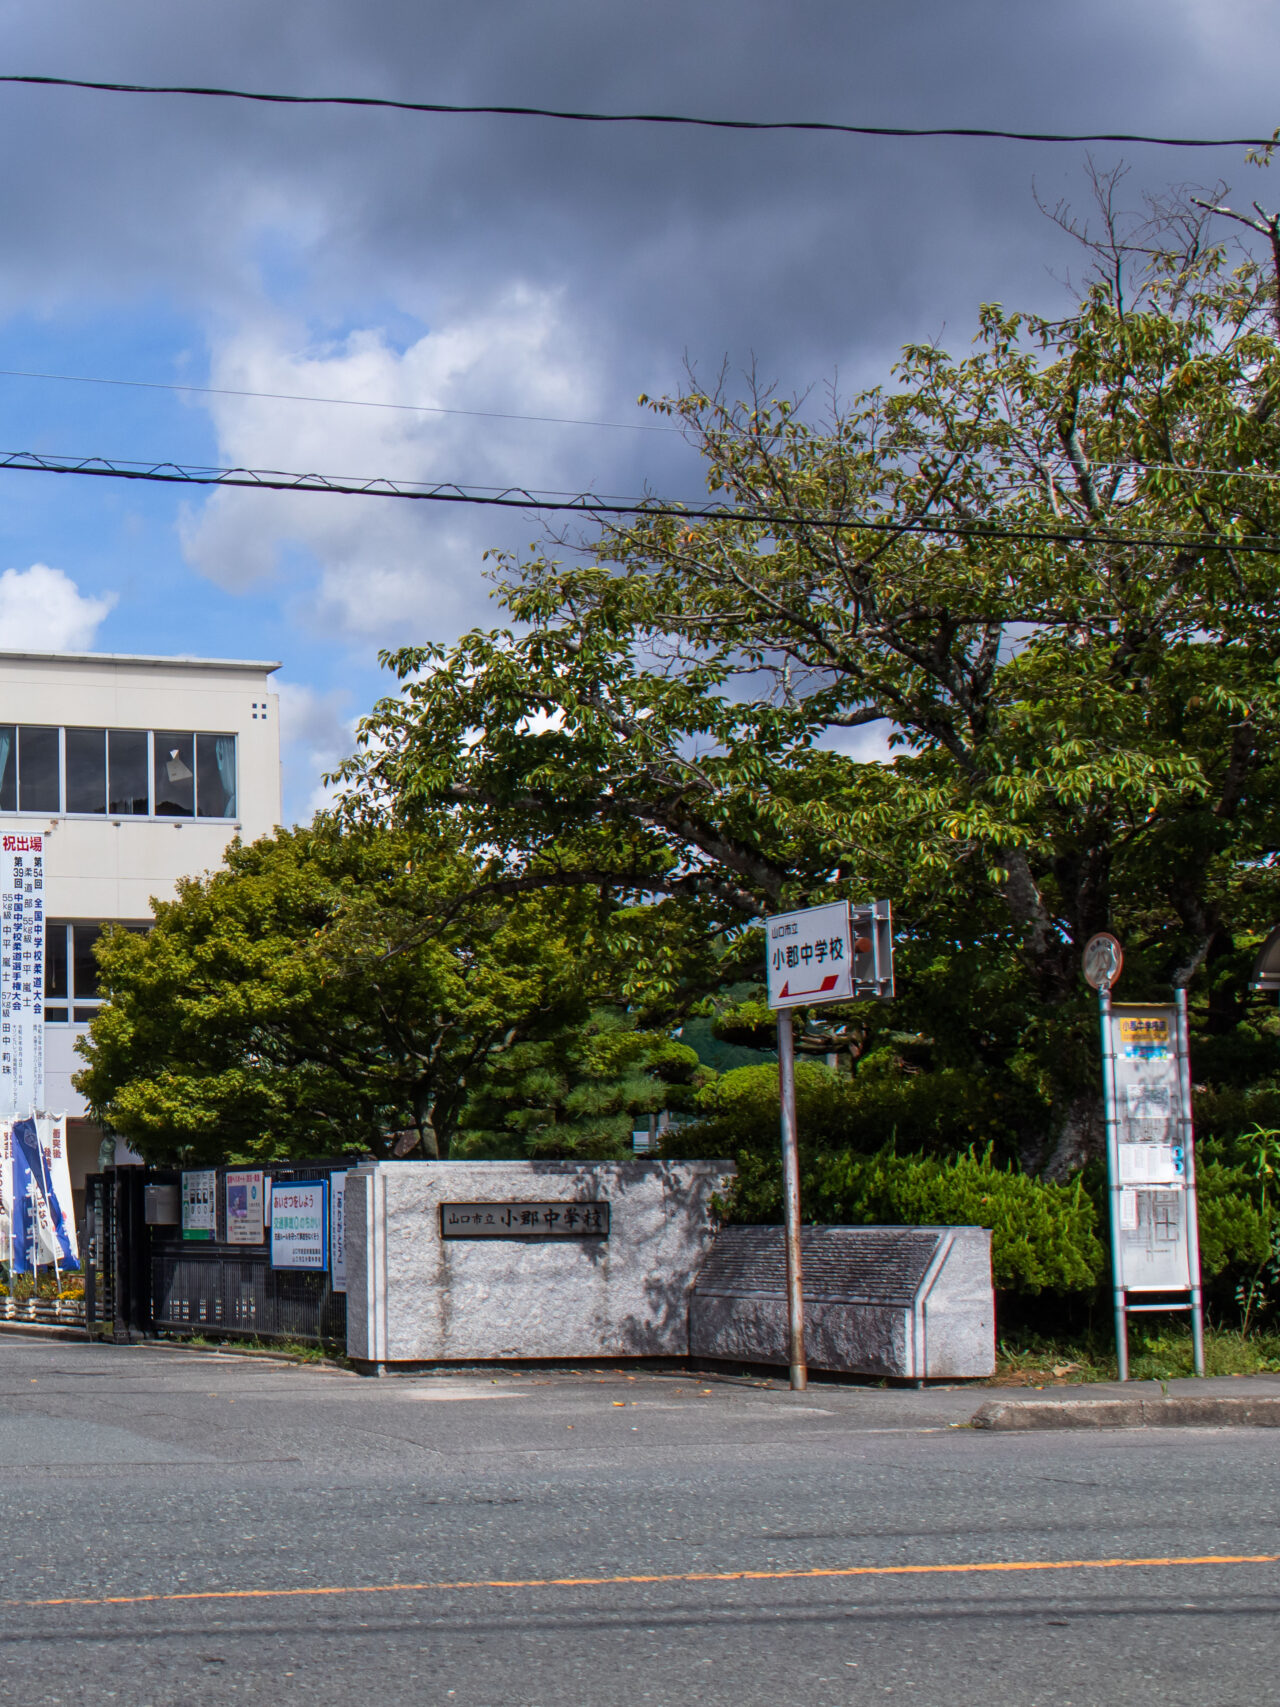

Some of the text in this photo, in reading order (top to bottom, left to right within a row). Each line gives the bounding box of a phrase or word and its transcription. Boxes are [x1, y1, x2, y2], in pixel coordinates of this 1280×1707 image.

[2, 835, 43, 852] 祝出場
[13, 856, 24, 889] 第39回
[33, 856, 43, 890] 第54回
[23, 867, 33, 909] 柔道部
[771, 922, 798, 939] 山口市立
[772, 936, 844, 971] 小郡中学校
[273, 1194, 314, 1209] あいさつをしよう
[448, 1207, 603, 1229] 山口市立 小郡中学校
